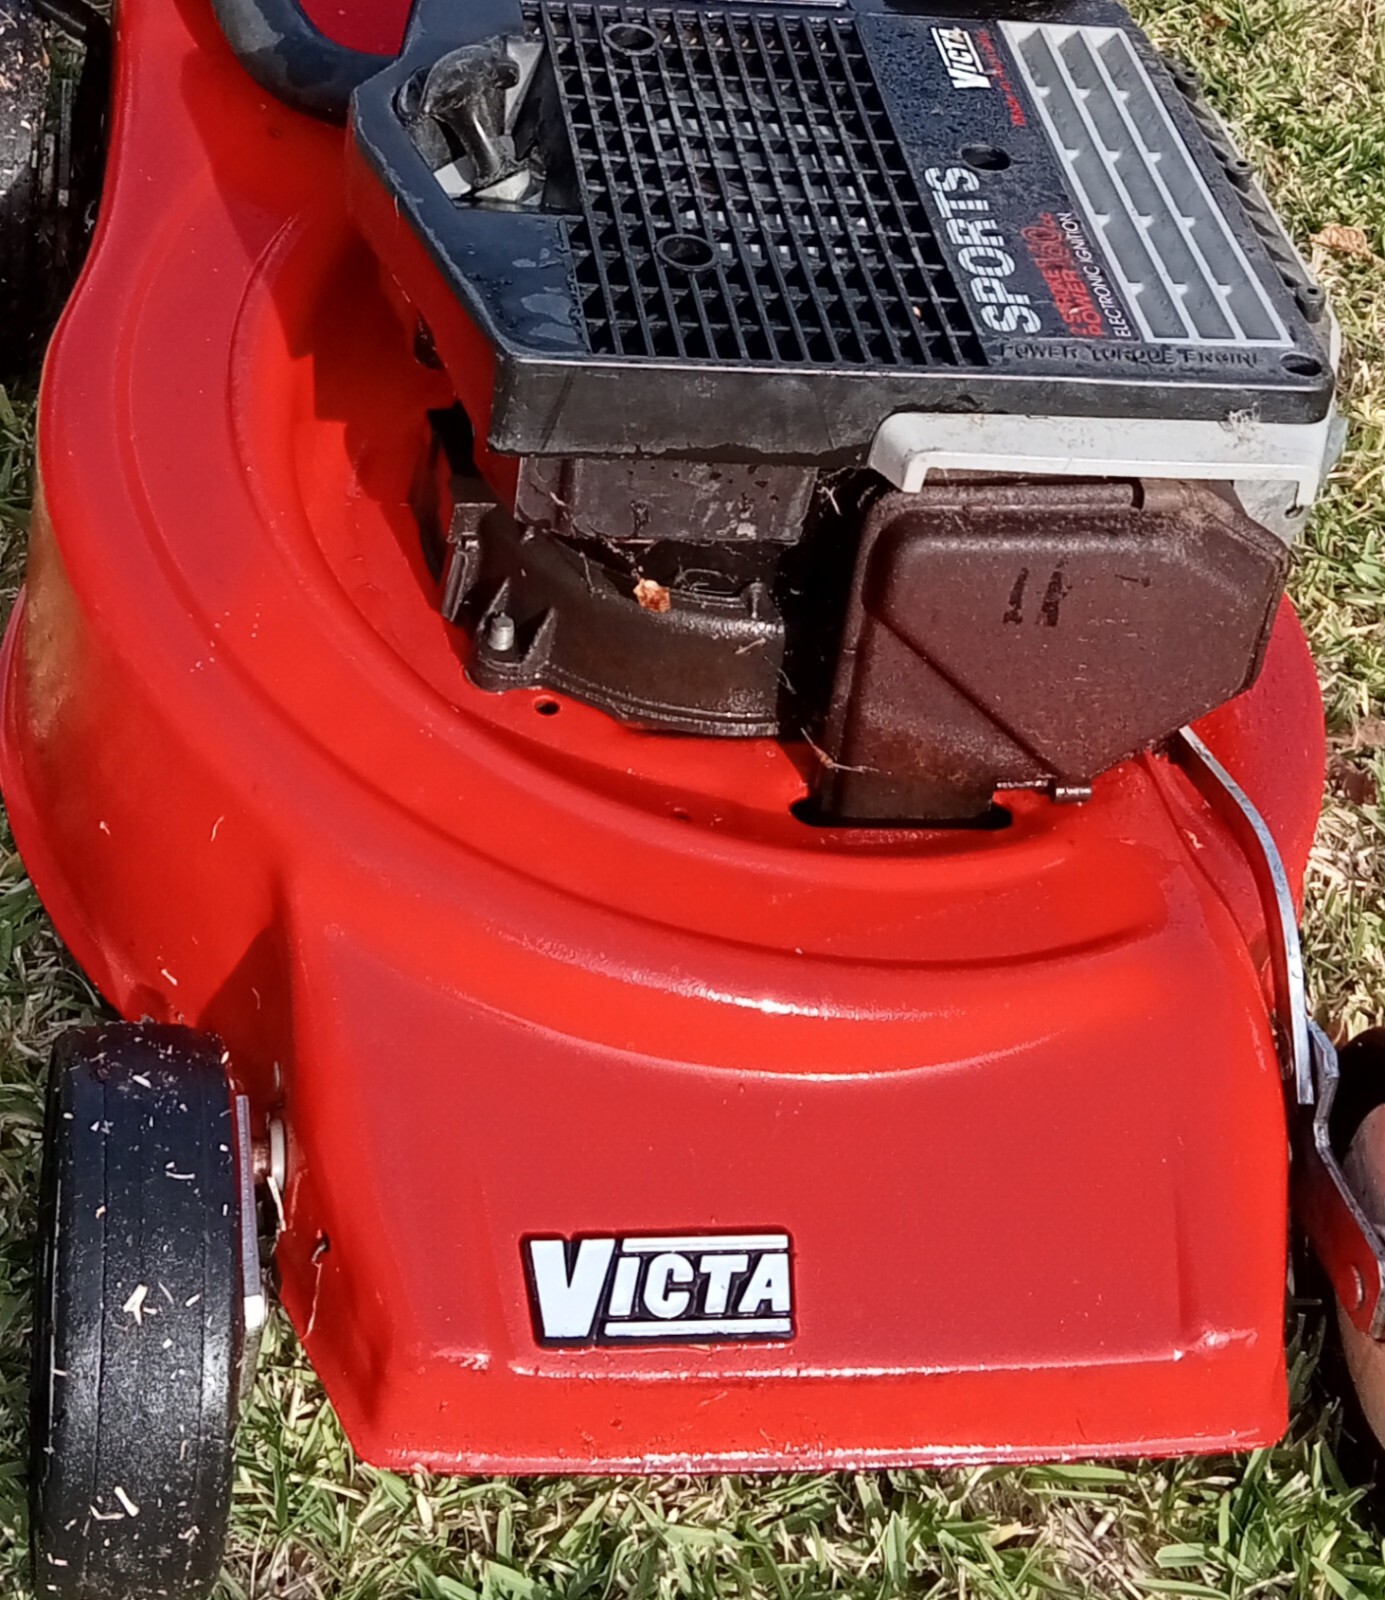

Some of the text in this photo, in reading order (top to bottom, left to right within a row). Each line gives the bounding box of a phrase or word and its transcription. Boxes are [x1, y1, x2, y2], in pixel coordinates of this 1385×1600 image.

[933, 27, 991, 88] VICTA
[924, 167, 1041, 333] SPORTS
[1057, 212, 1131, 337] ELECTRONIC IGNITION
[1062, 269, 1104, 336] POWER
[1000, 343, 1077, 359] POWER
[530, 1235, 791, 1338] VICTA
